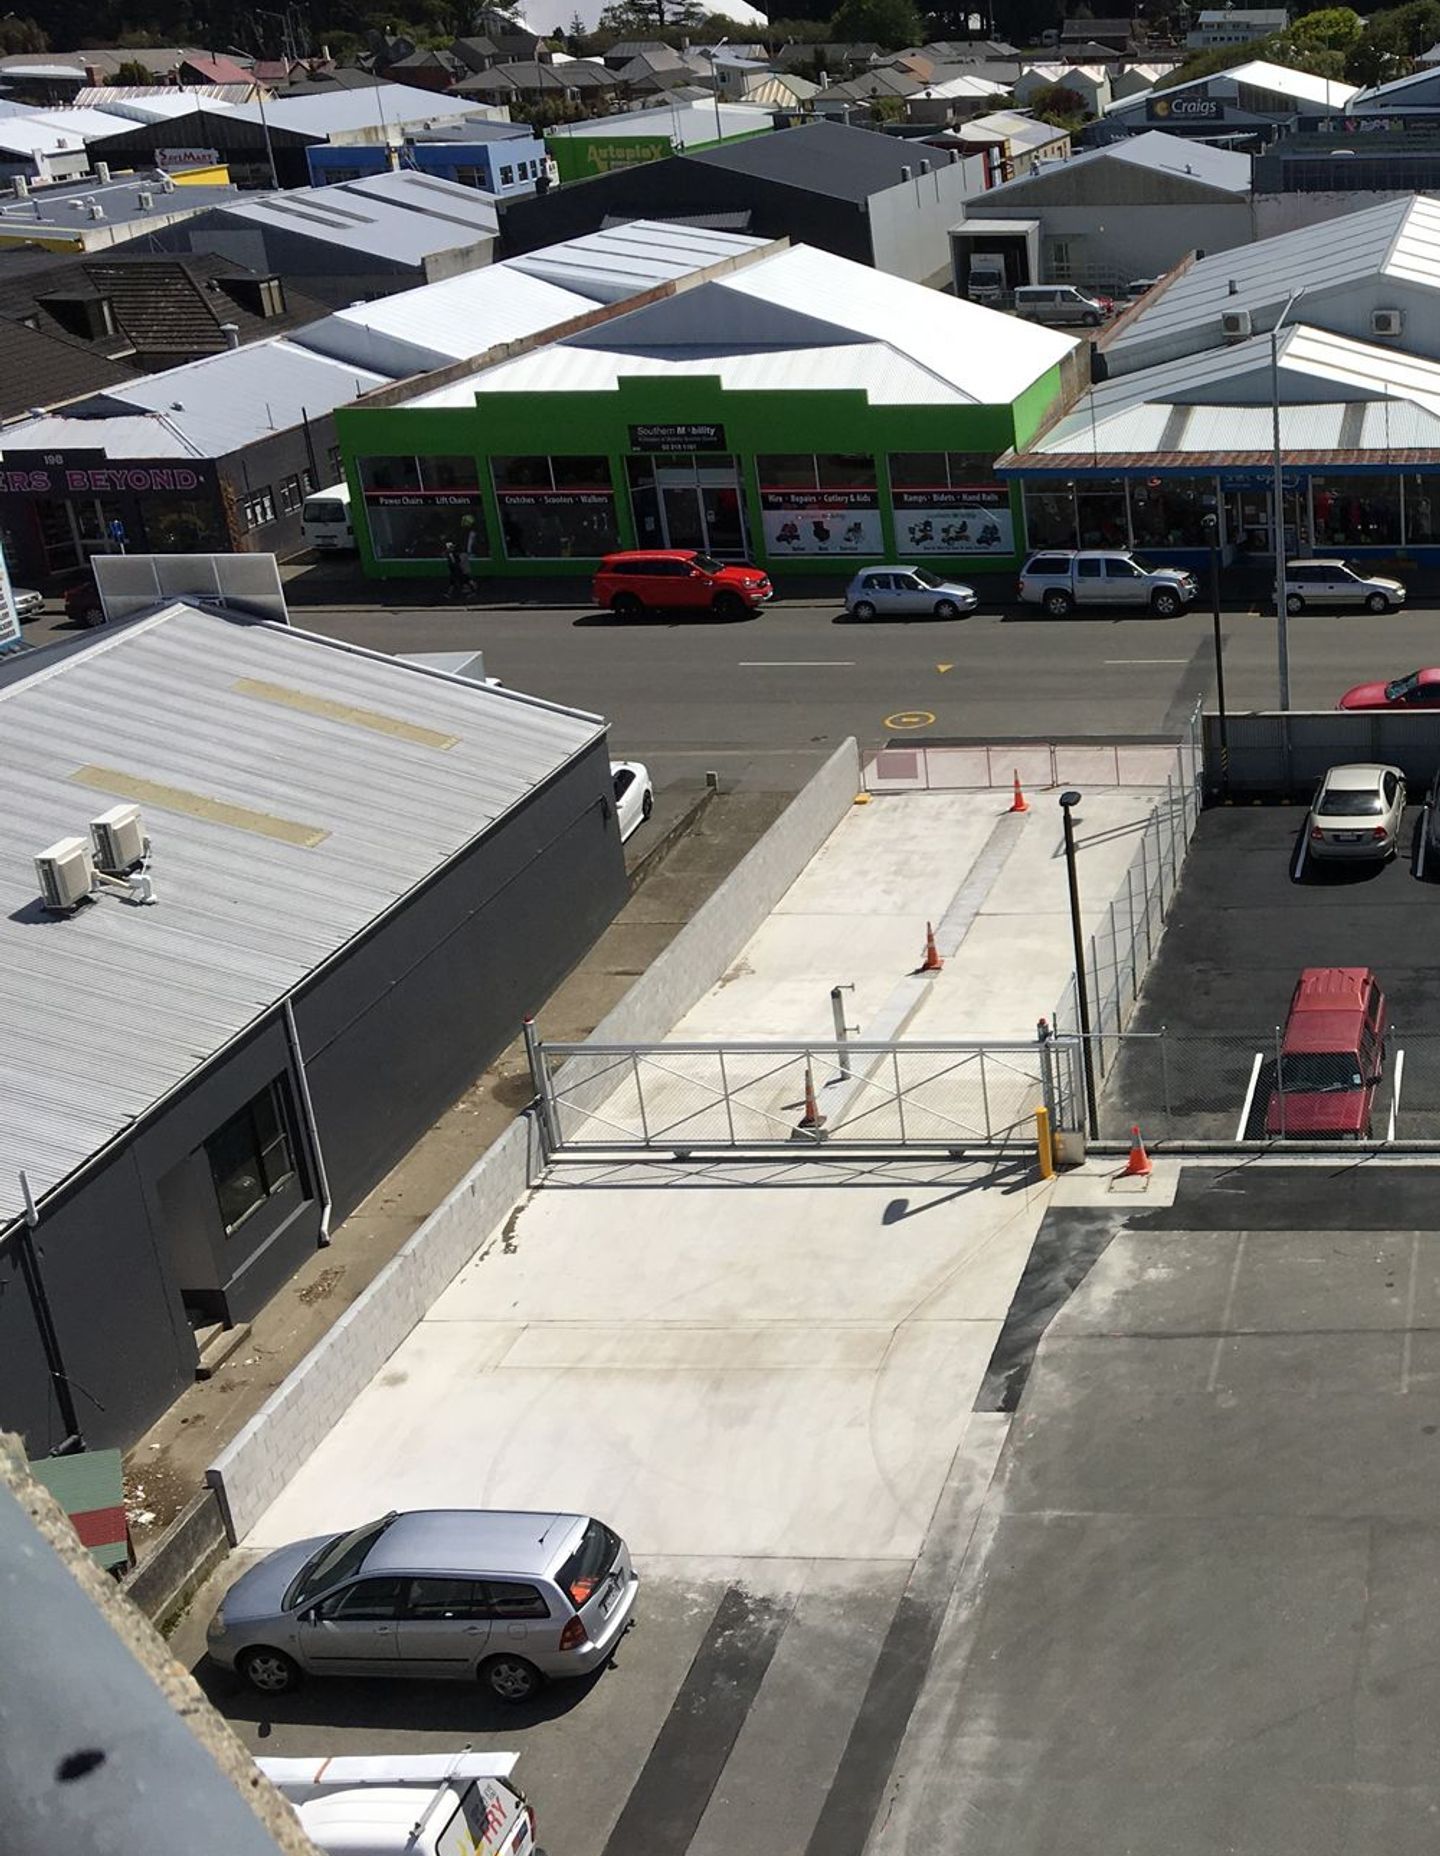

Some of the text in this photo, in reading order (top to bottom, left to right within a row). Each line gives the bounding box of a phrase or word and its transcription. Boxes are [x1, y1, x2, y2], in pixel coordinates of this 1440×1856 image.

[1171, 98, 1217, 116] Craigs
[637, 426, 676, 436] Southern
[44, 454, 64, 466] 198
[65, 468, 198, 491] BEYOND
[380, 496, 471, 505] Power Chairs Lift Chairs
[790, 493, 817, 503] Repairs
[823, 493, 848, 503] Cutlery
